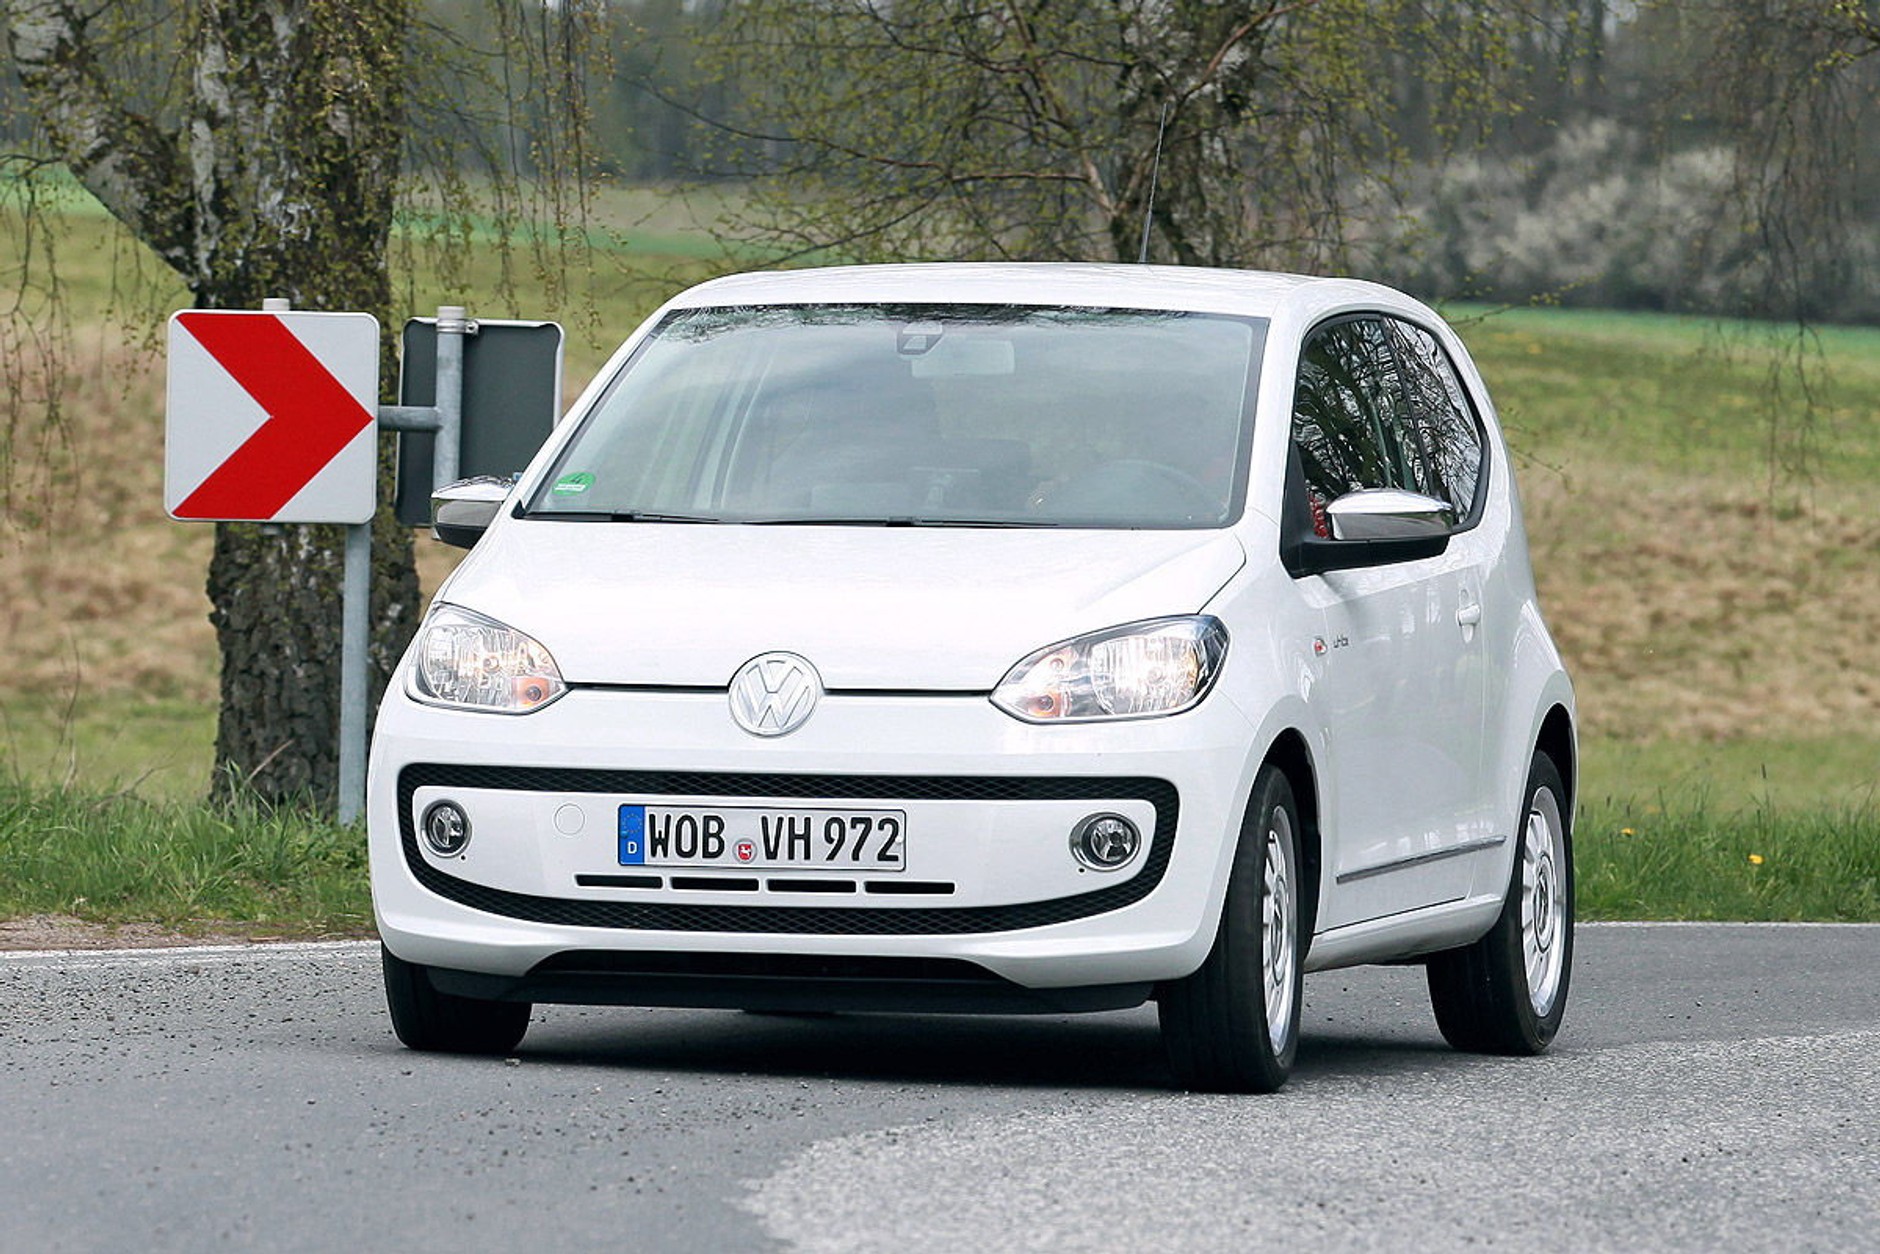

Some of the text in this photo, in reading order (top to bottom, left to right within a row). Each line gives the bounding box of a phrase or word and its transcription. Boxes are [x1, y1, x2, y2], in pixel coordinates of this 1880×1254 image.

[735, 657, 814, 733] VW
[626, 841, 638, 854] D
[648, 814, 900, 862] WOB VH 972
